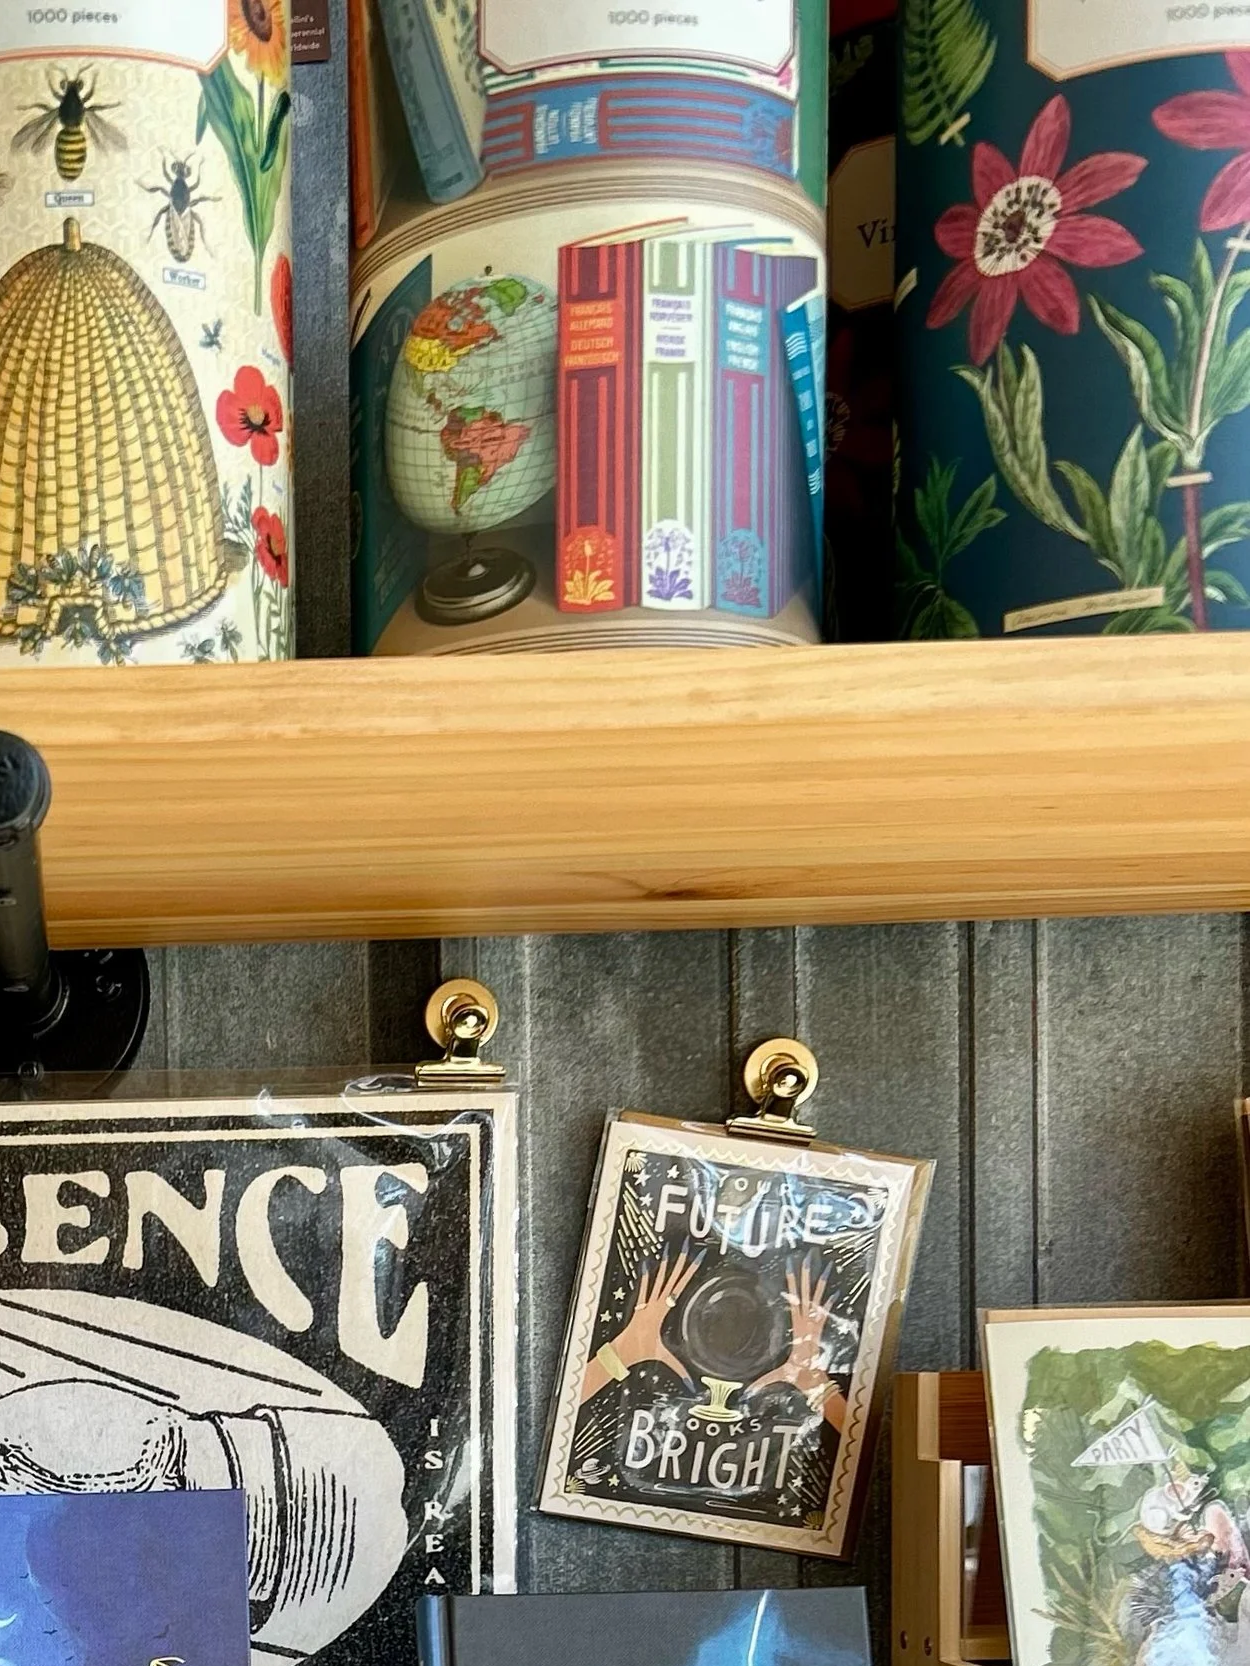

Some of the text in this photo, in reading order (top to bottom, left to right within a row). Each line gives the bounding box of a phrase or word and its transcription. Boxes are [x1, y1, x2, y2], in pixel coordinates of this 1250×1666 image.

[26, 9, 119, 25] 1000 pieces
[607, 10, 699, 27] 1000 pieces
[654, 1183, 834, 1259] FUTURE
[623, 1408, 801, 1491] BRIGHT
[1091, 1417, 1150, 1462] PARTY
[423, 1500, 447, 1586] REA
